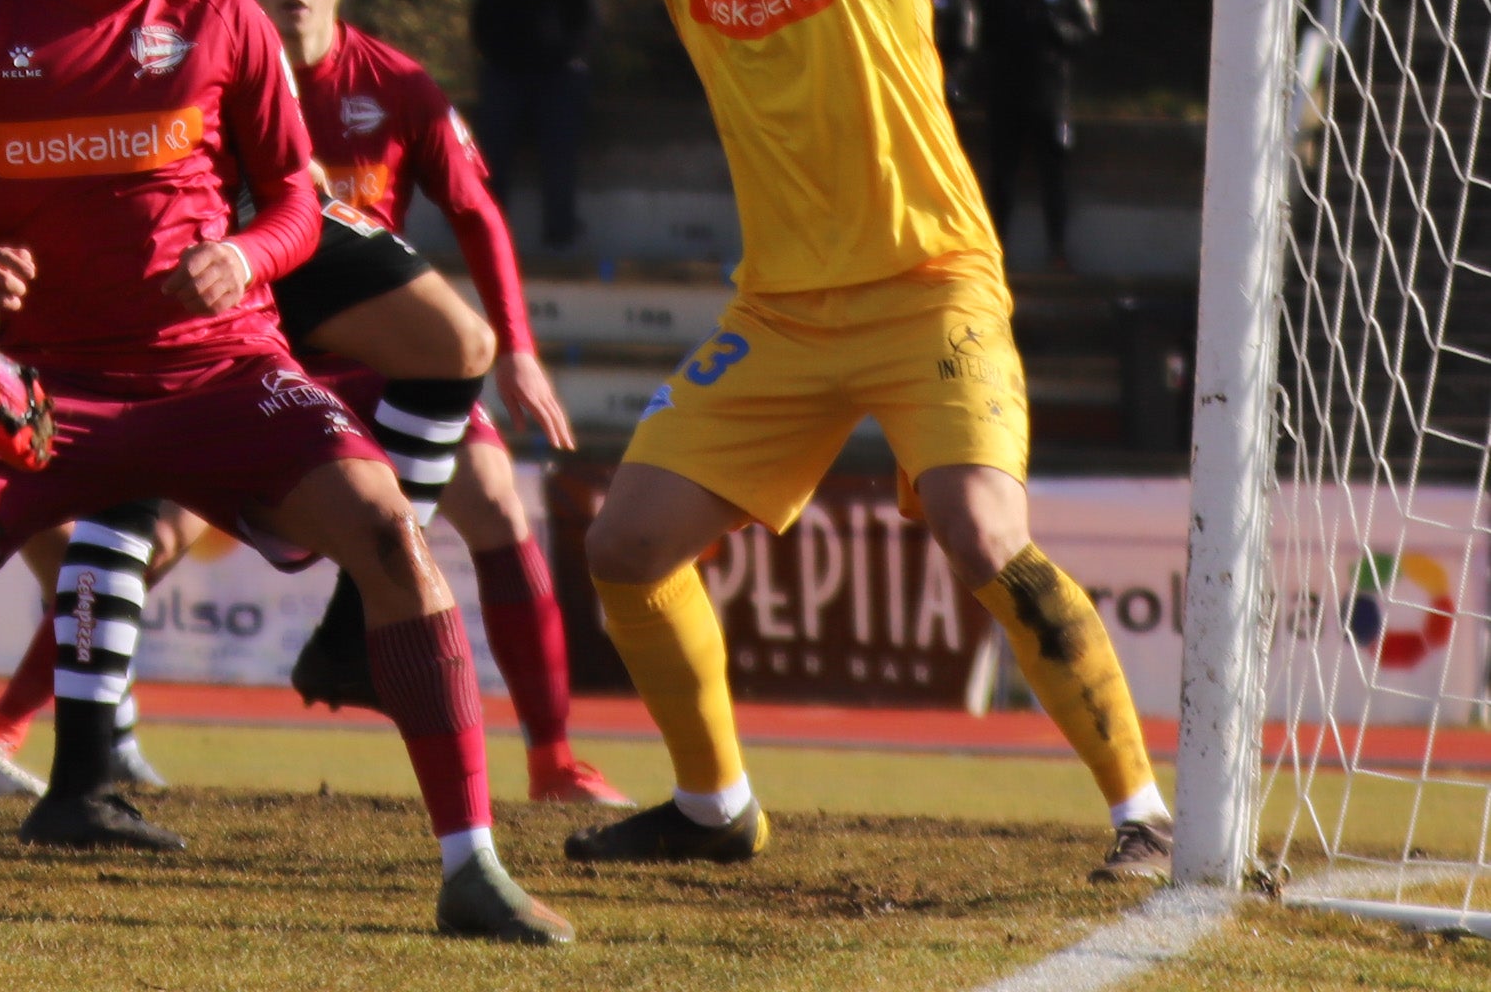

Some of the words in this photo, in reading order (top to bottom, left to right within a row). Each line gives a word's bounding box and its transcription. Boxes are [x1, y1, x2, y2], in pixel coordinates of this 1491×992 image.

[1, 68, 43, 79] KELME
[5, 124, 159, 165] euskaltel
[673, 325, 750, 387] 3
[72, 571, 97, 664] telepizza
